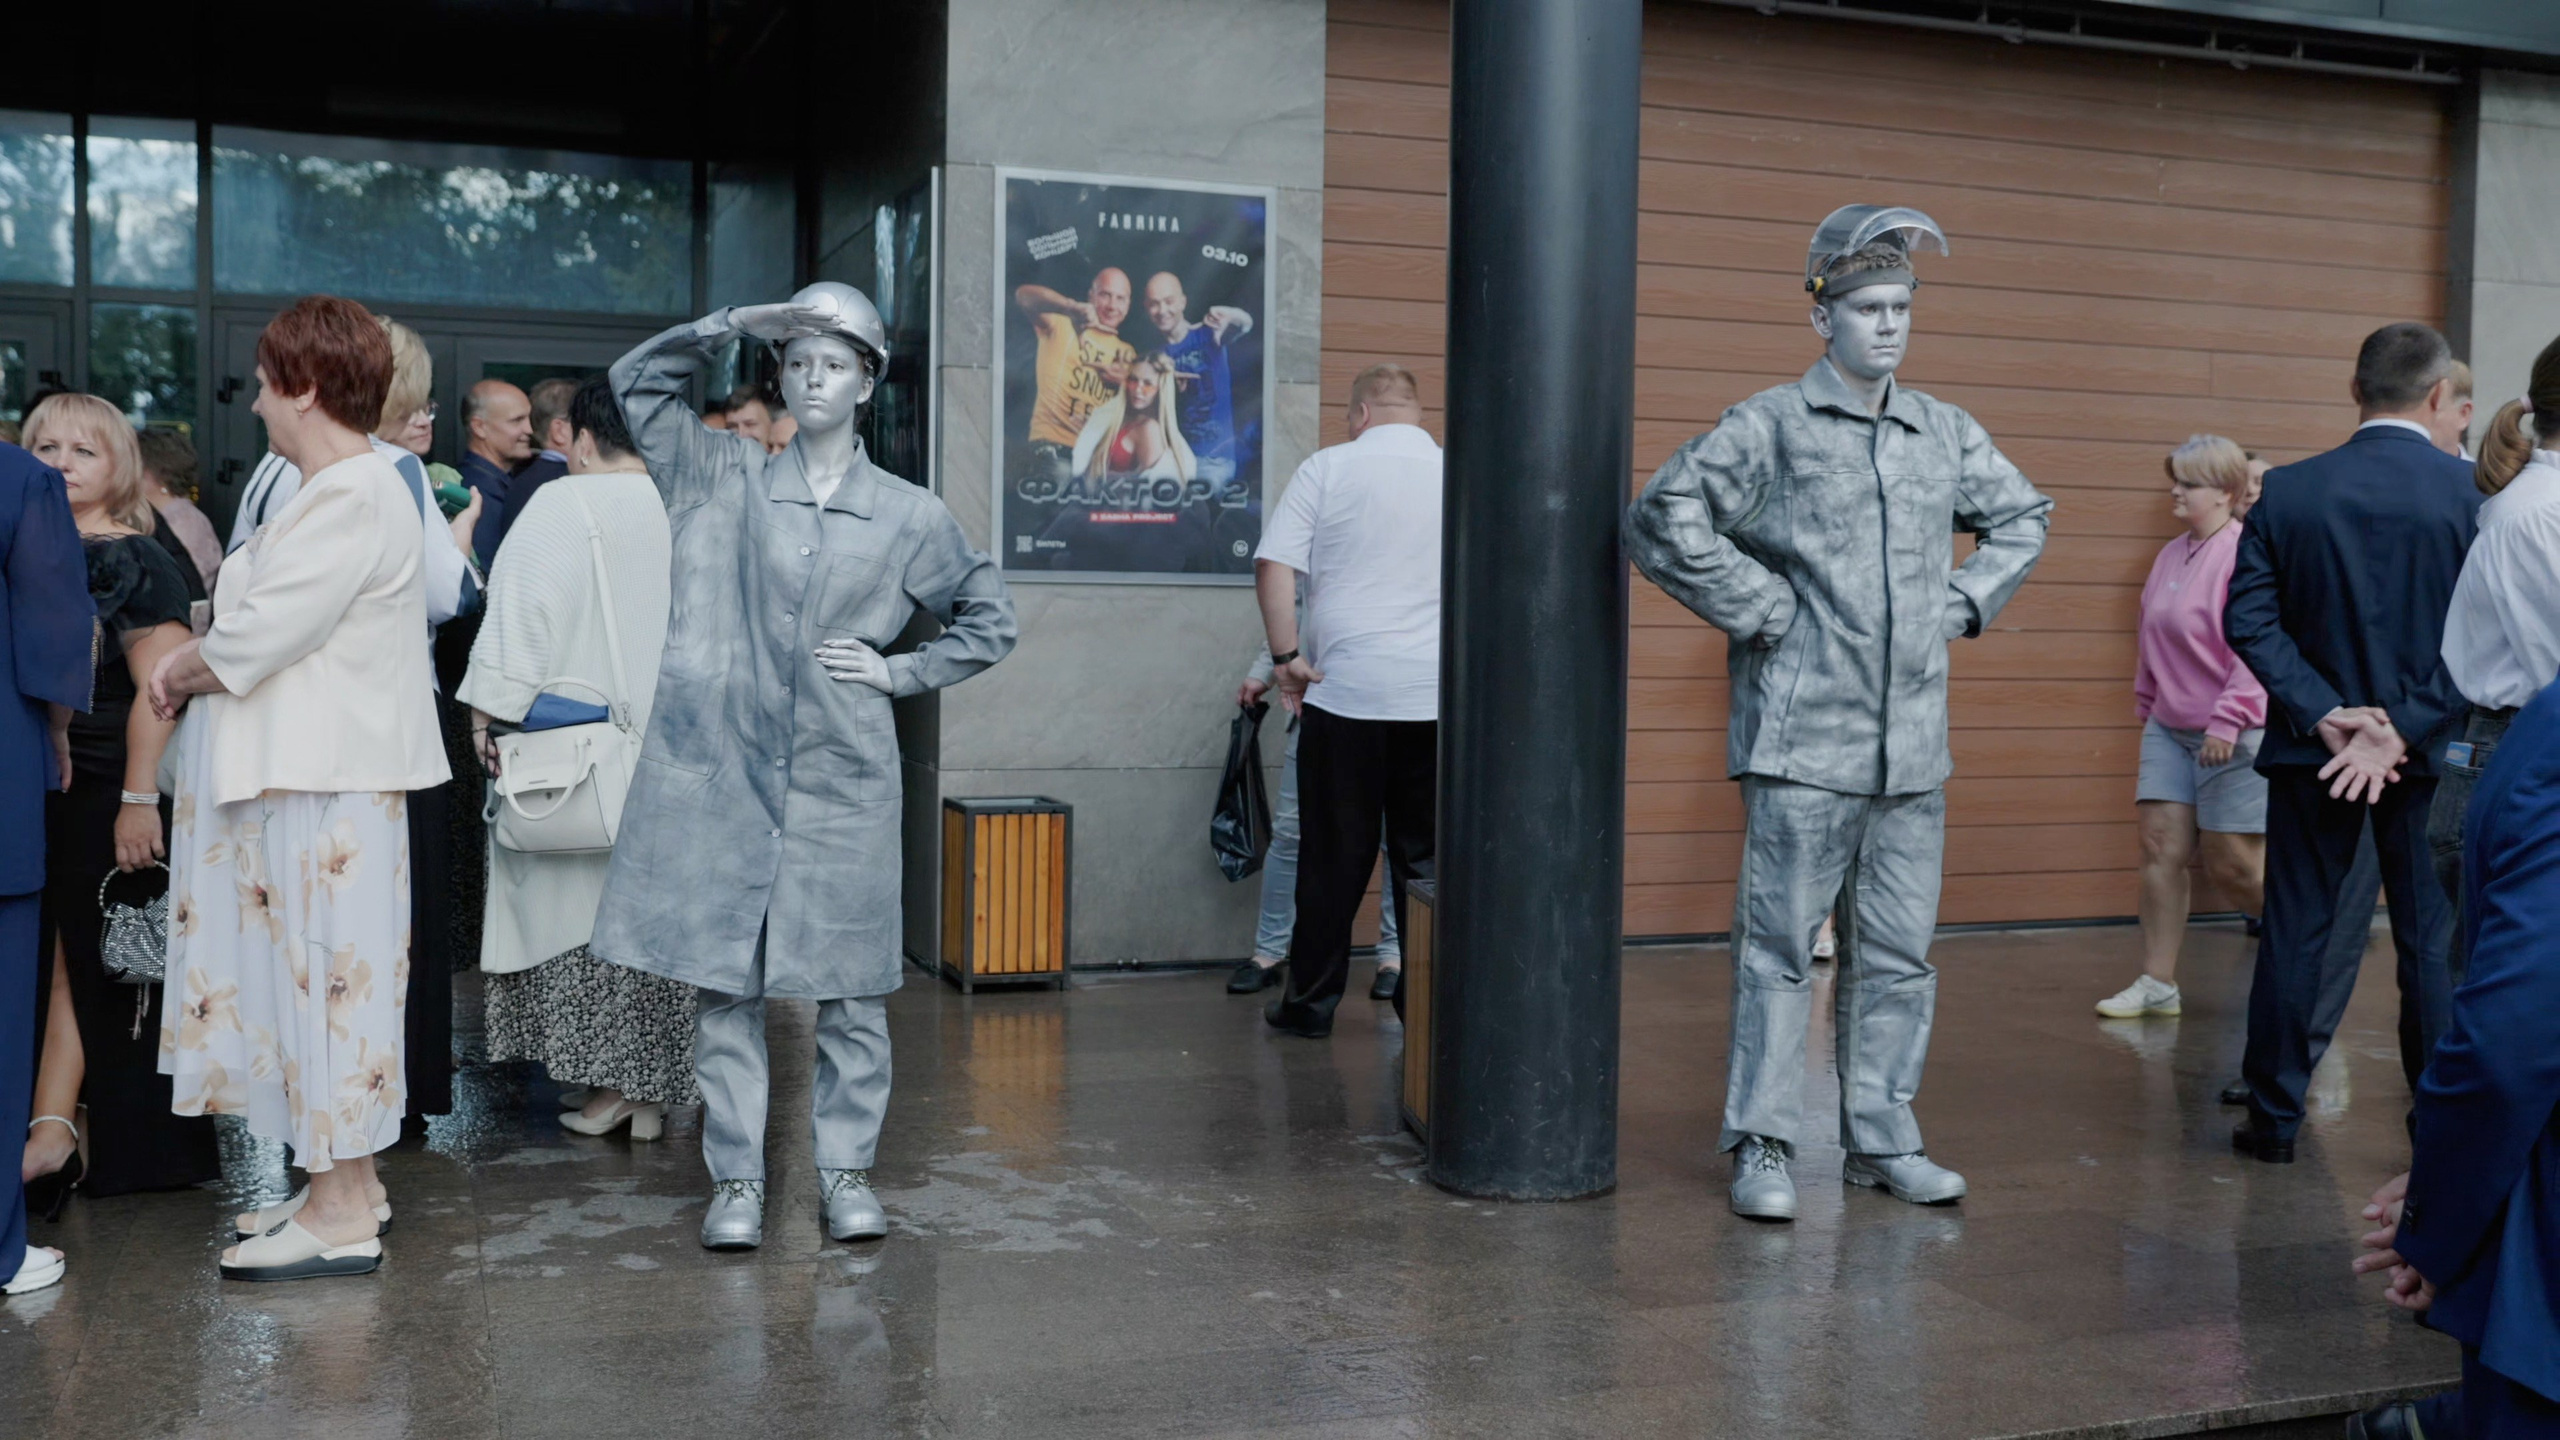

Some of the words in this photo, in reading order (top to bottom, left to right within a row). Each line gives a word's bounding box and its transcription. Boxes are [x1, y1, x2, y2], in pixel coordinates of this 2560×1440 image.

[1099, 211, 1180, 233] FABRIKA
[1202, 245, 1248, 267] 03.10
[1016, 476, 1213, 508] ФАКТОР
[1219, 480, 1249, 508] 2
